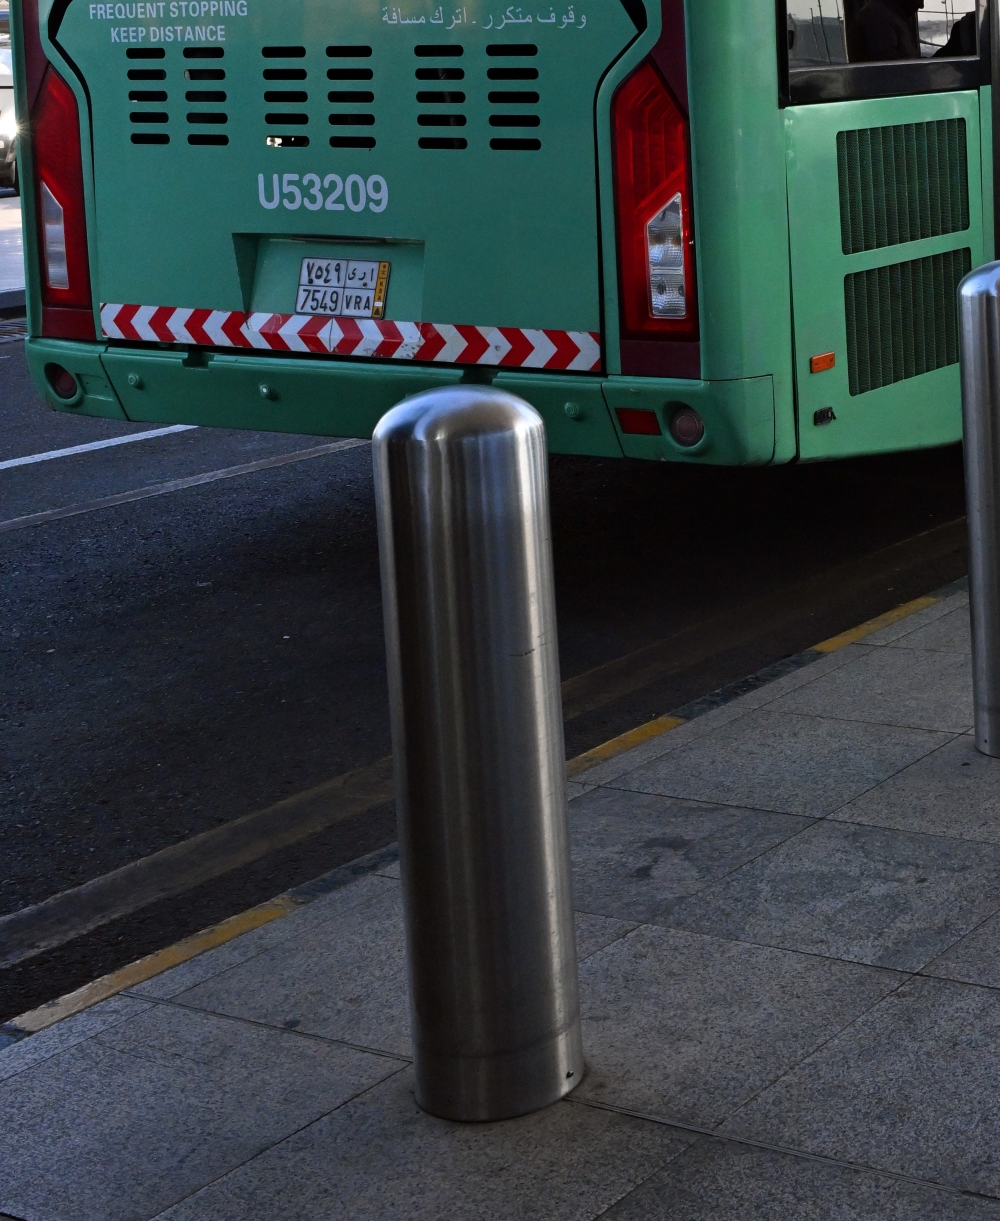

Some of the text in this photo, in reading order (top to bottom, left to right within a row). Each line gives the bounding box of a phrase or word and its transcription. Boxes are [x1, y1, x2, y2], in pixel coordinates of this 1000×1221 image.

[89, 0, 248, 20] FREQUENT STOPPING
[382, 6, 426, 24] مسافة
[110, 25, 226, 43] KEEP DISTANCE
[257, 173, 389, 213] U53209
[300, 288, 339, 312] 7549
